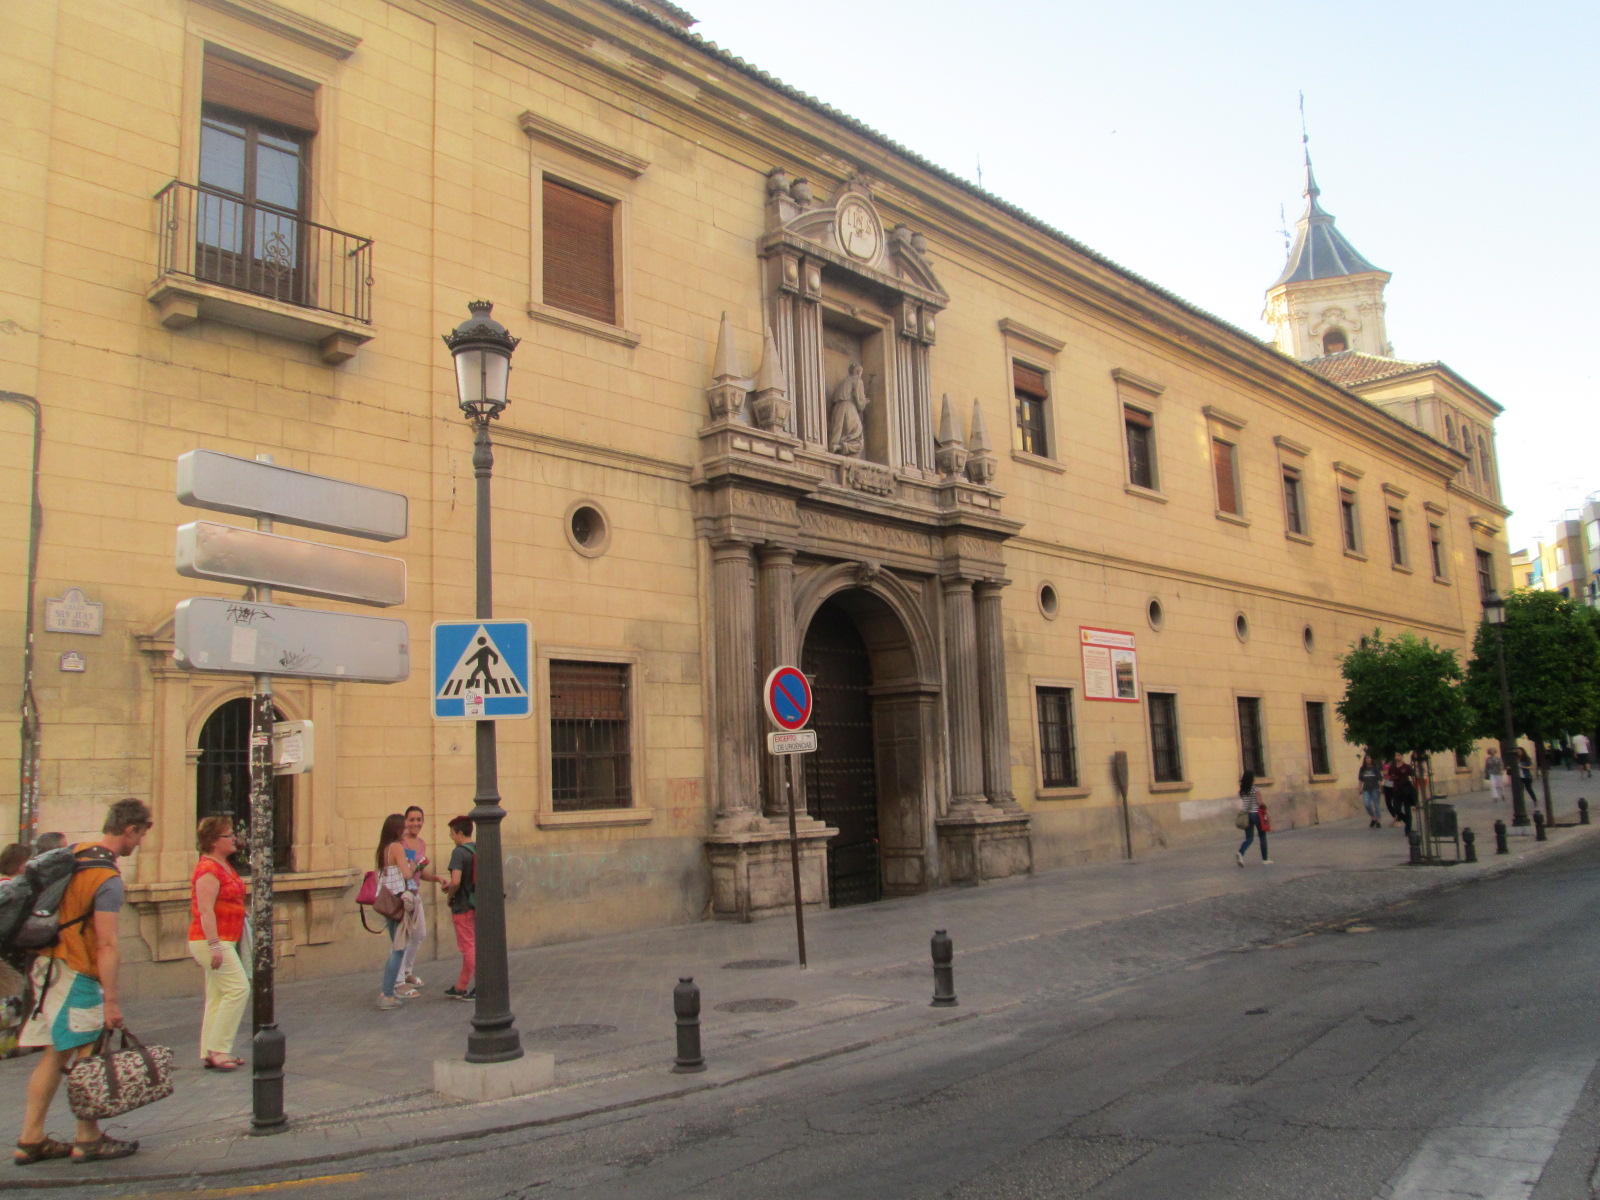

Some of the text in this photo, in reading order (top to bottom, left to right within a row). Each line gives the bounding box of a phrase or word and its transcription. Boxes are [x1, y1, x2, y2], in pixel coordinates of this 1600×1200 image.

[55, 609, 95, 620] SAN JUAN
[58, 618, 90, 628] DE DIOS
[774, 734, 797, 743] EXCEPTO
[777, 741, 812, 751] DE URGENCIAS
